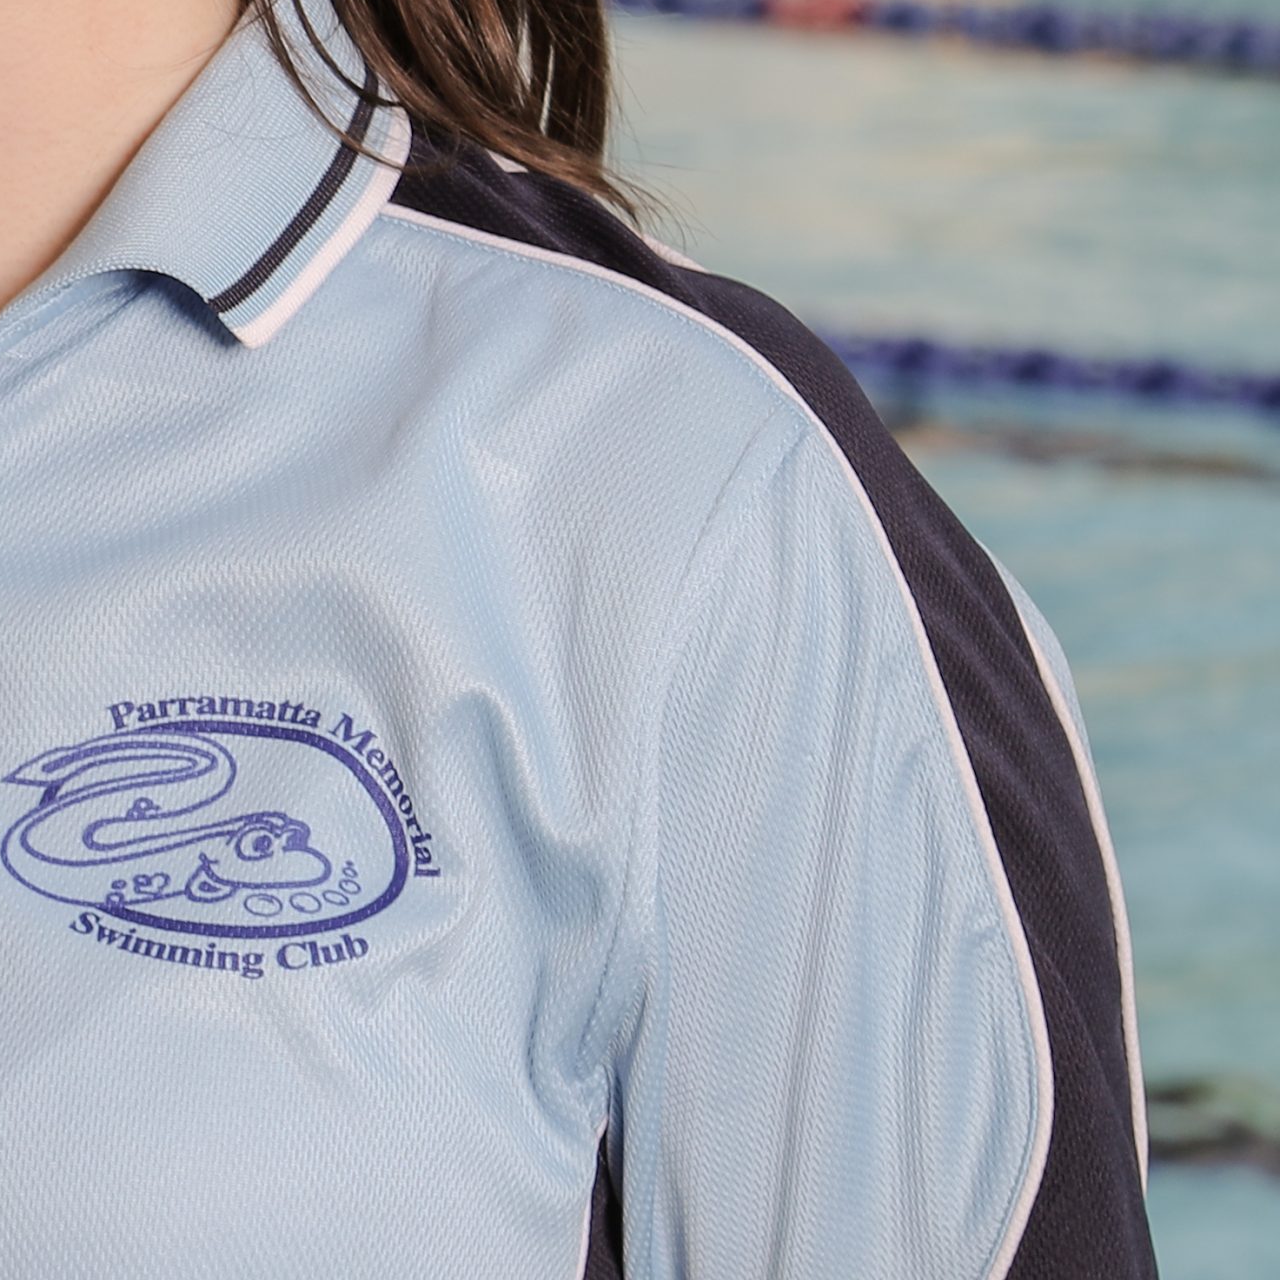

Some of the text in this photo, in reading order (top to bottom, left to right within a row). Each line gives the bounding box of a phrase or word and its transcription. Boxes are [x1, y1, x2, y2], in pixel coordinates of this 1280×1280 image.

[106, 695, 441, 878] Parramatta Memorial
[68, 910, 370, 979] Swimming Club
